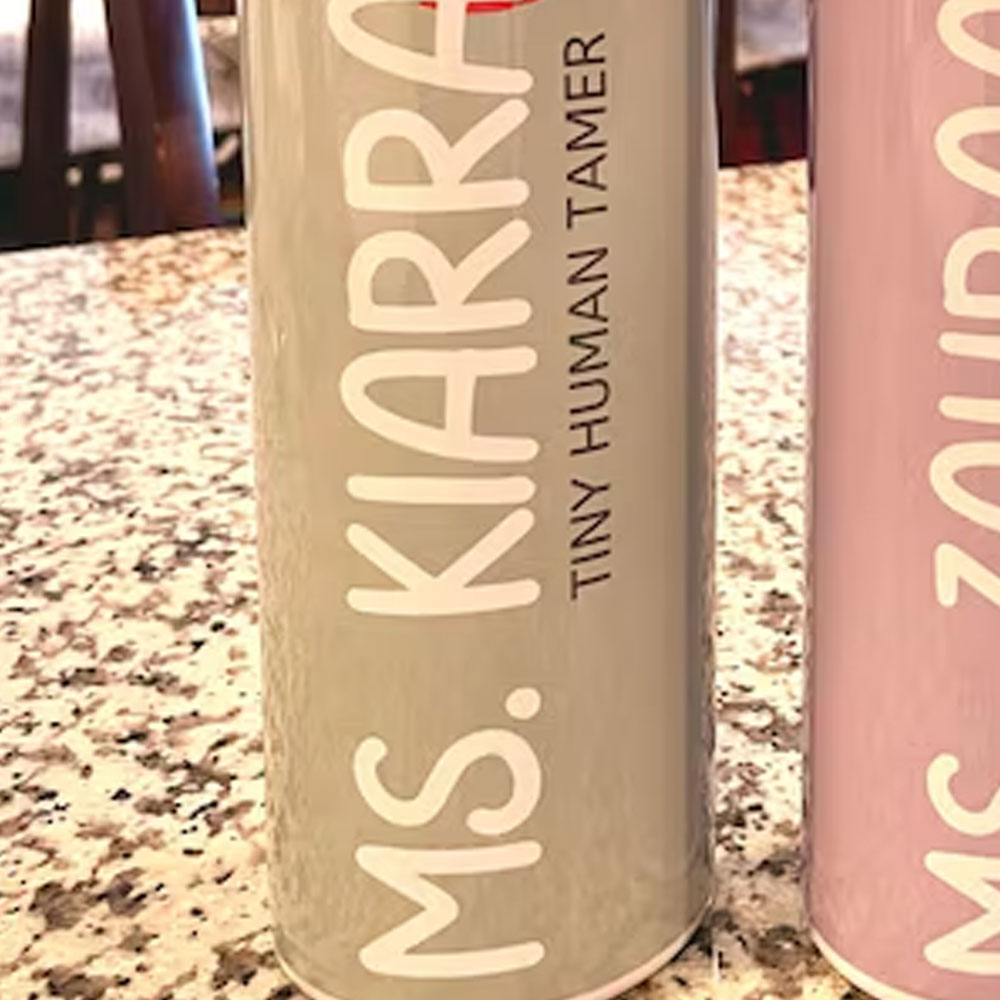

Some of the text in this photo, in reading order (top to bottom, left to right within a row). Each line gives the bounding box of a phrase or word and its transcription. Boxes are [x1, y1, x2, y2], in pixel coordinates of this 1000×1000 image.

[562, 30, 612, 600] TINY HUMAN TAMER
[353, 686, 545, 978] MS.
